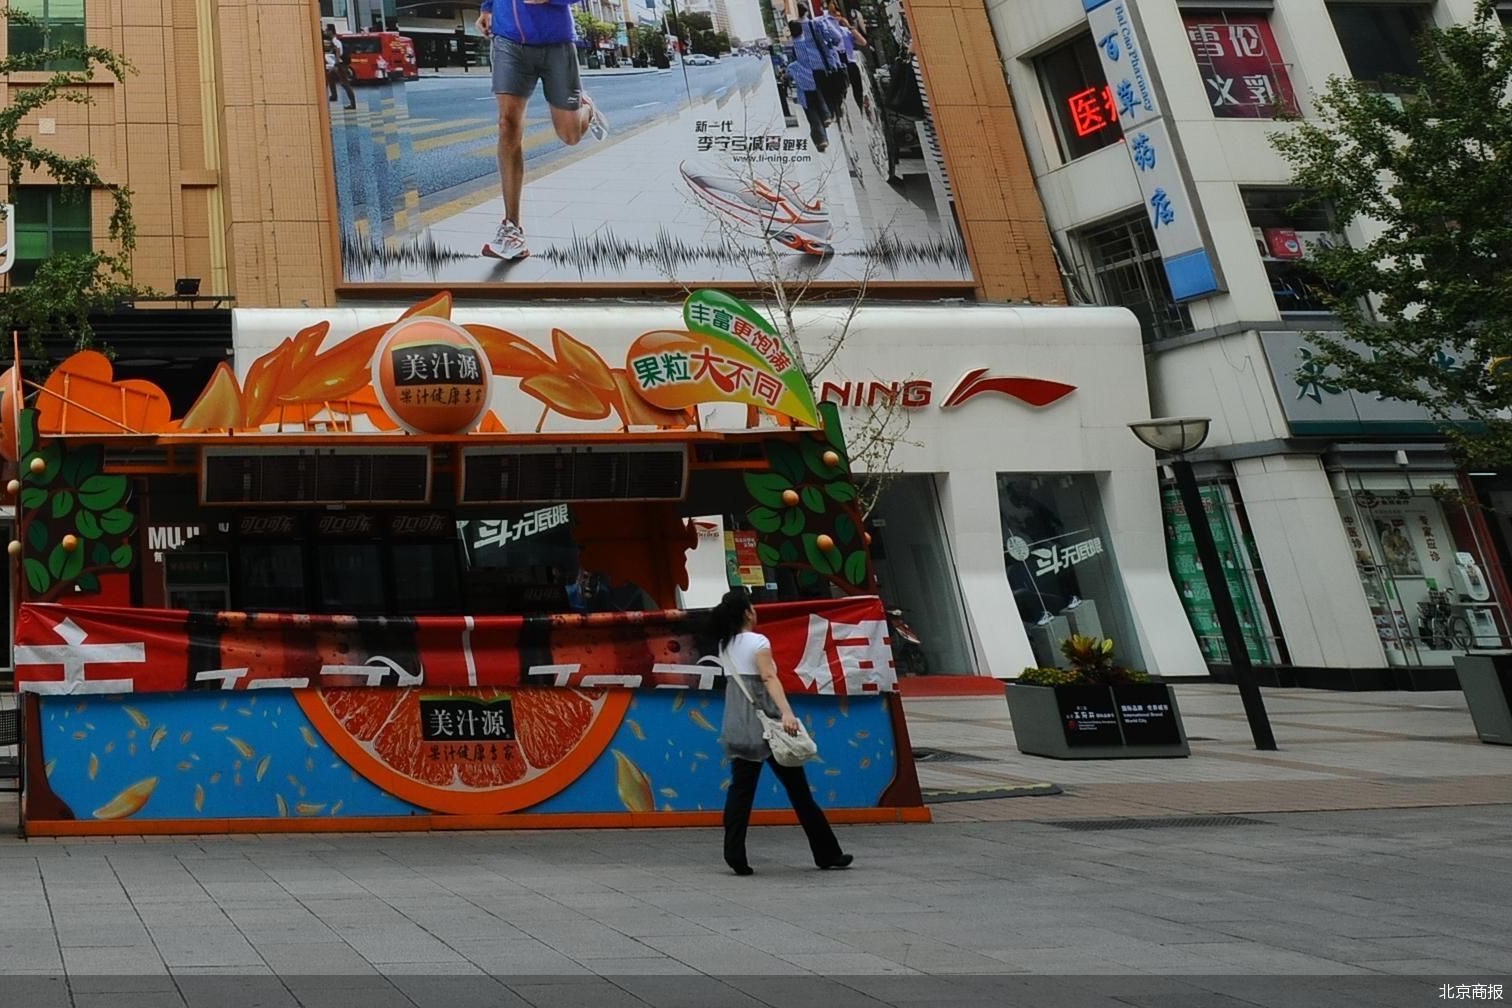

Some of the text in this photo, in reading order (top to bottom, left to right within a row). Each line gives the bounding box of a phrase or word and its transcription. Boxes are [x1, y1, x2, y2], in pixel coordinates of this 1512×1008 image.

[1128, 50, 1154, 112] Pharmacy
[695, 121, 733, 132] 新一代
[733, 155, 811, 164] www.li-ning.com
[691, 303, 792, 373] 丰富更饱满
[401, 352, 479, 380] 美汁源
[633, 347, 783, 406] 果粒大不同
[430, 709, 506, 736] 美汁源
